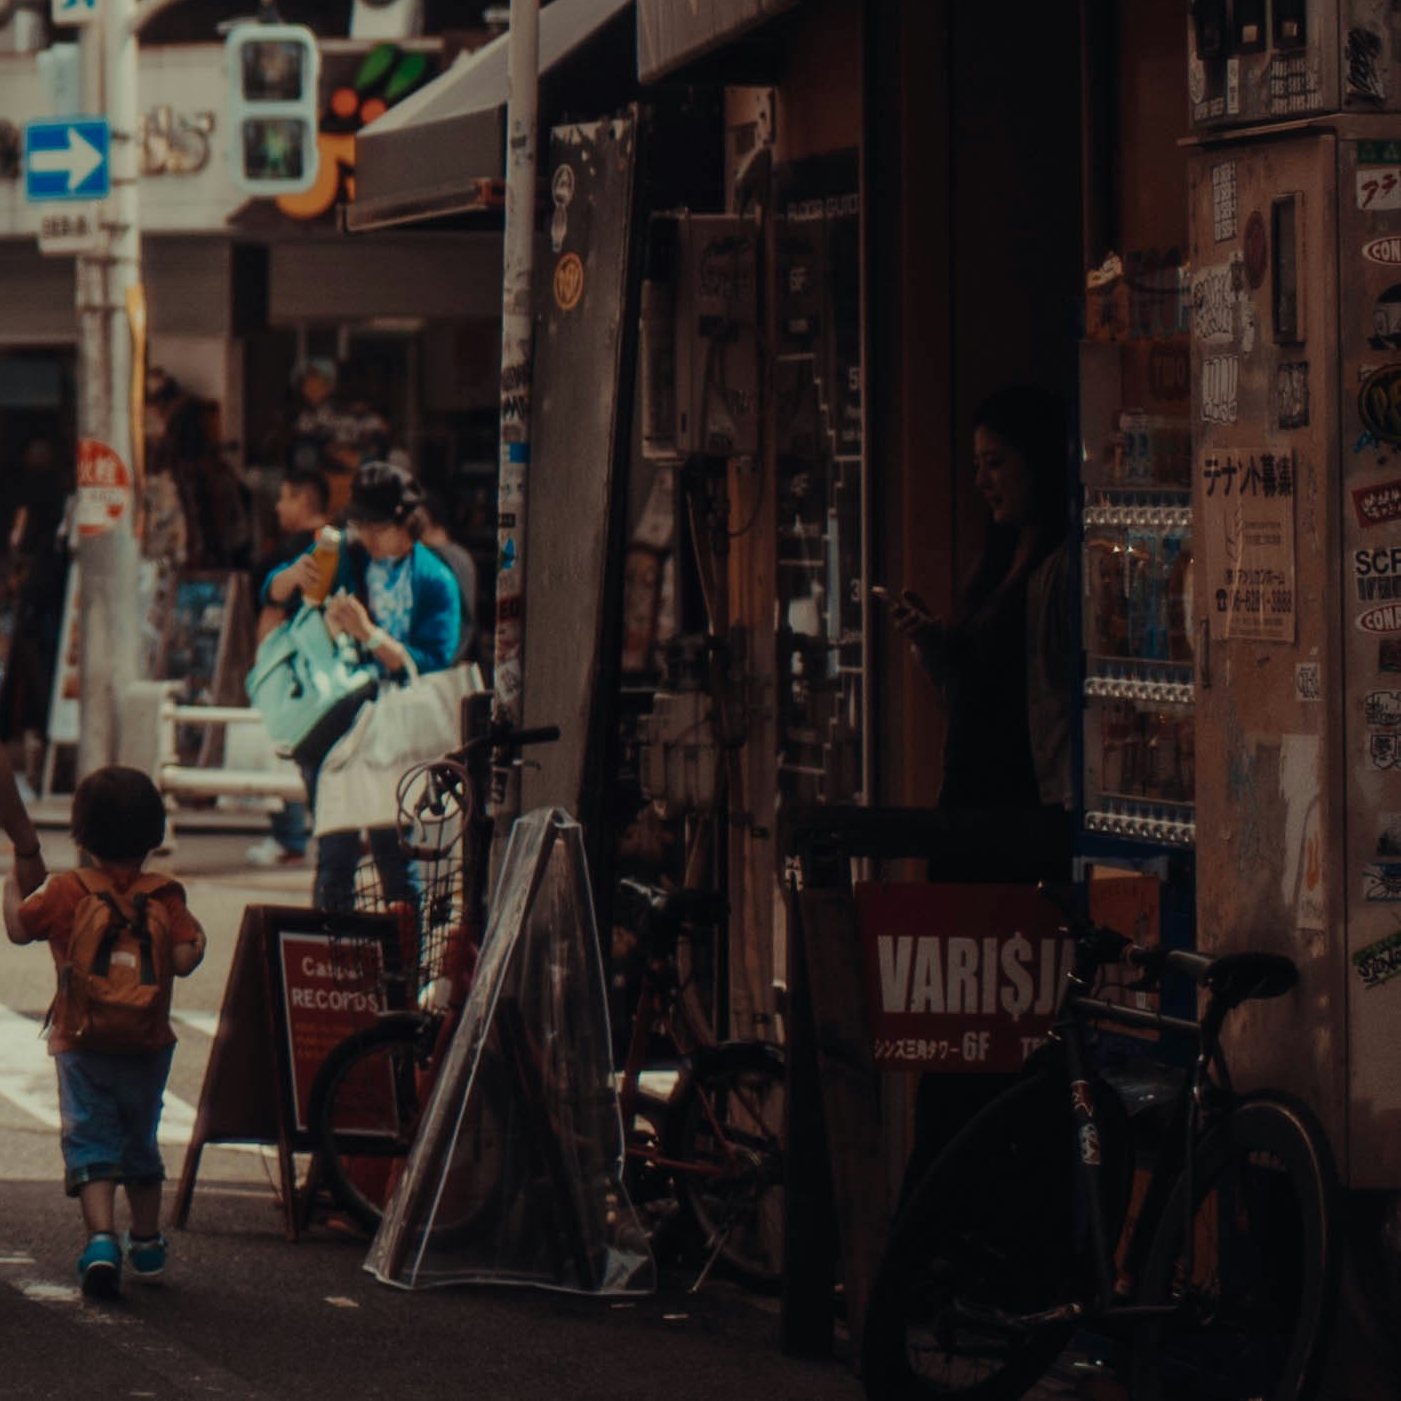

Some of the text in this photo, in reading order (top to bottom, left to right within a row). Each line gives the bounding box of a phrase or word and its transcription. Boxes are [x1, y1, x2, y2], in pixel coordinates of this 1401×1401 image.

[1203, 453, 1293, 498] テナント募集
[962, 1030, 991, 1063] 6F
